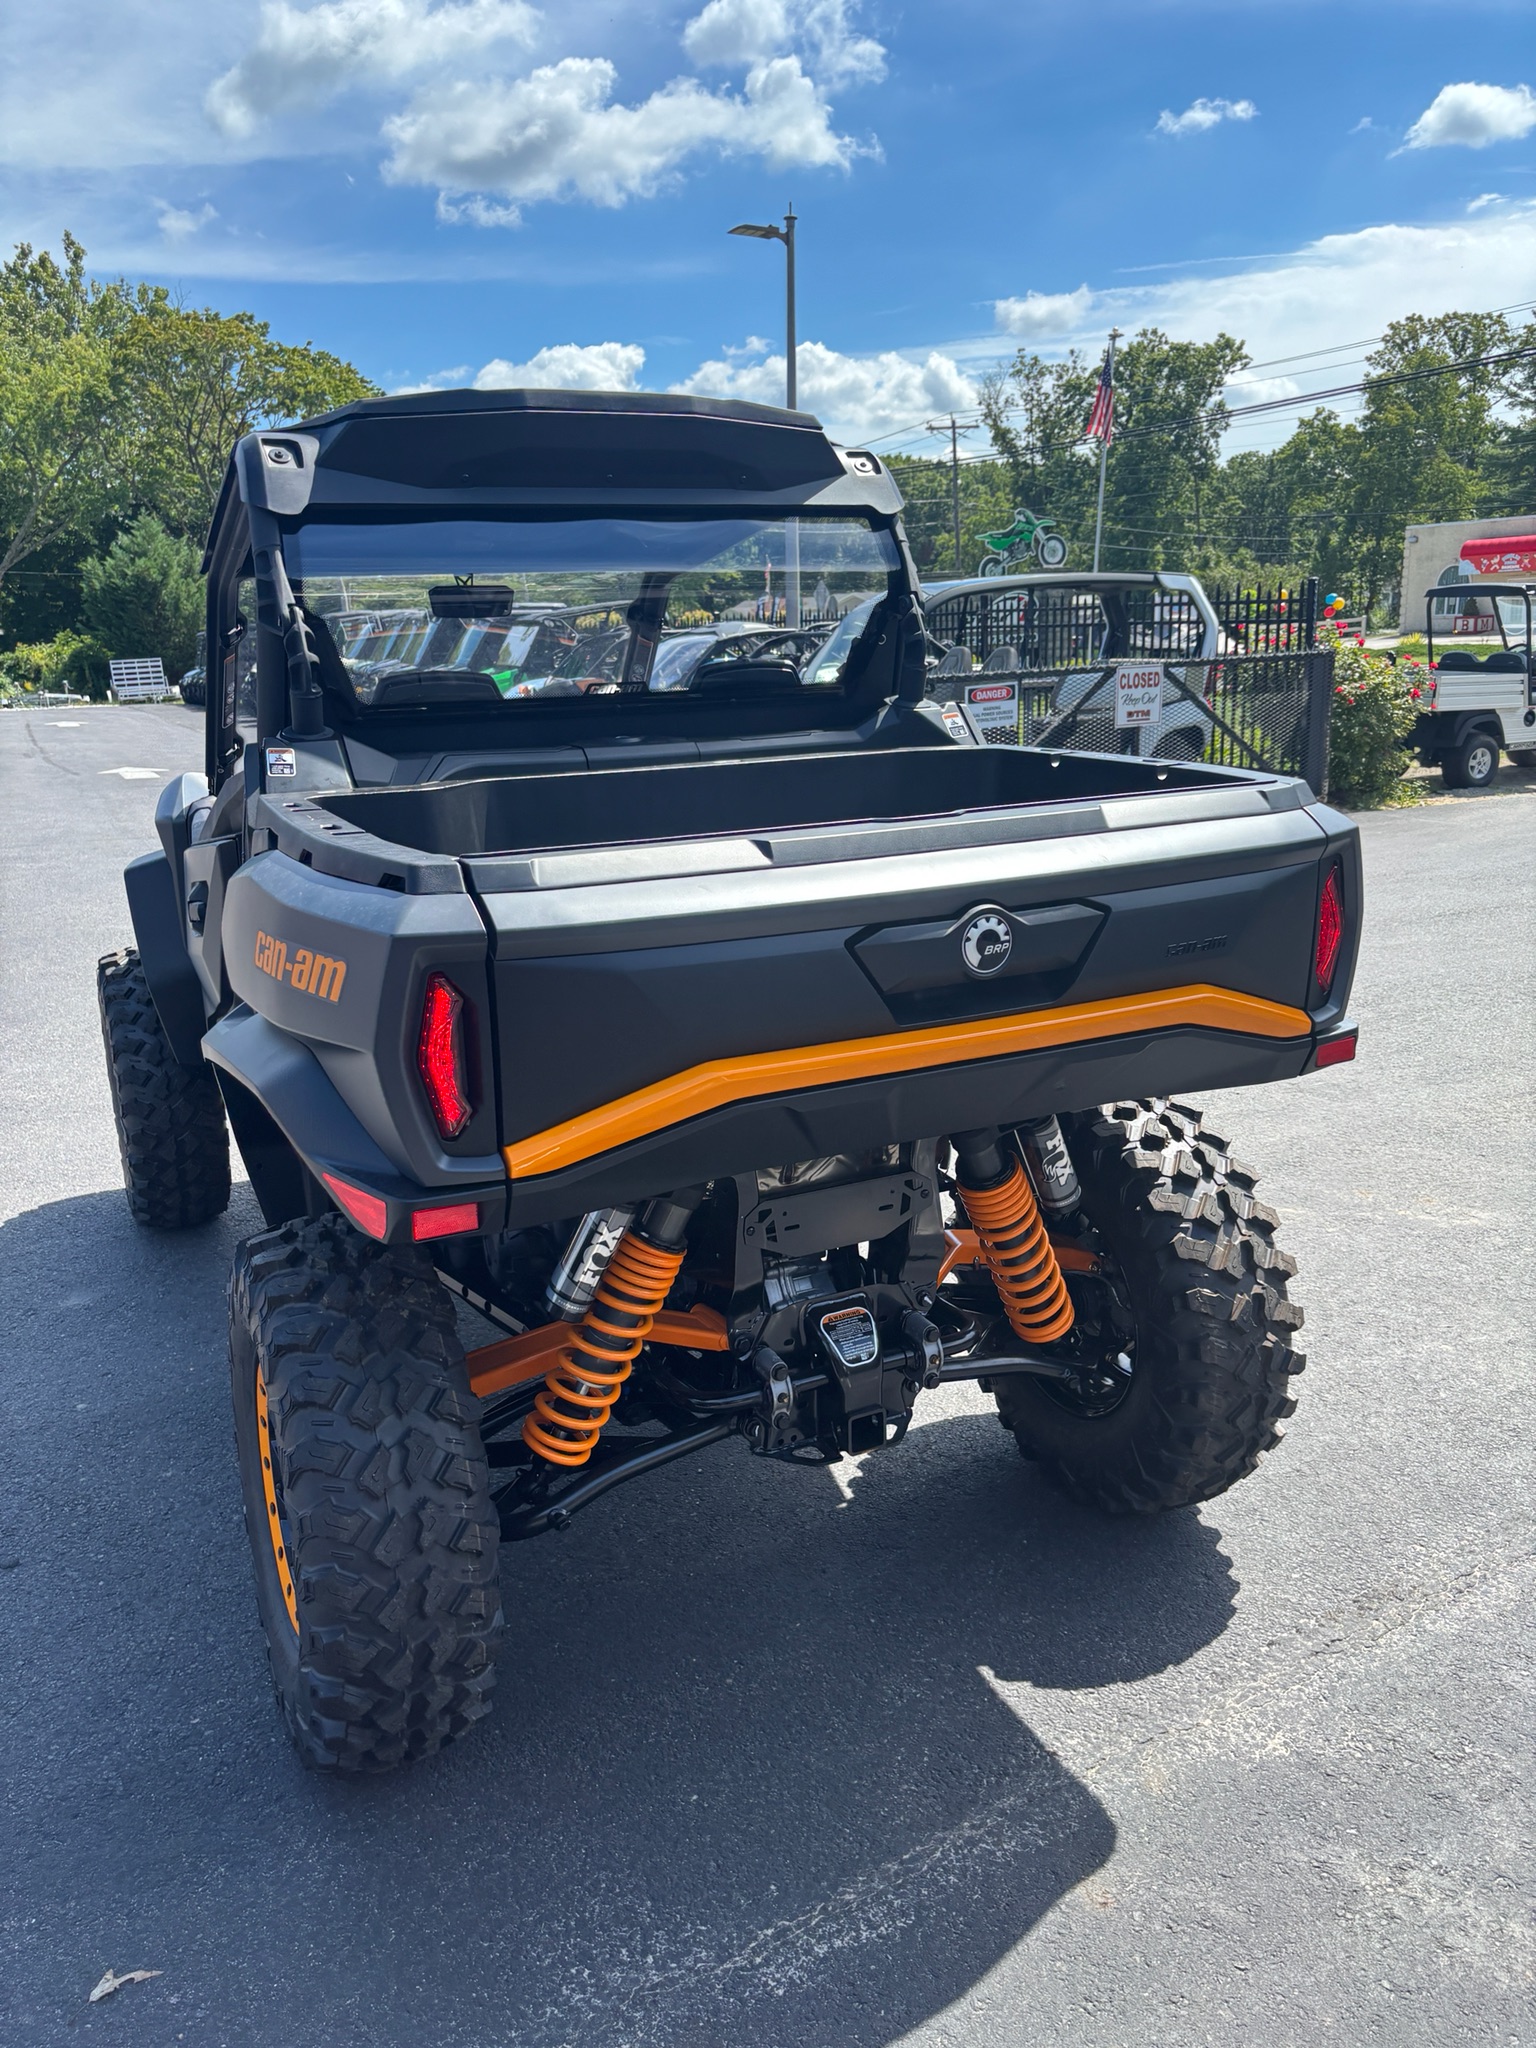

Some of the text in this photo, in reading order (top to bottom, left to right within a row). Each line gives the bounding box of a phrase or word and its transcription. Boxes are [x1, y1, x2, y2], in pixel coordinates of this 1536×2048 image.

[1120, 672, 1160, 690] CLOSED
[976, 689, 1007, 700] DANGER
[984, 942, 1010, 955] BRP
[255, 930, 347, 1003] can-am
[573, 1220, 625, 1287] FOX
